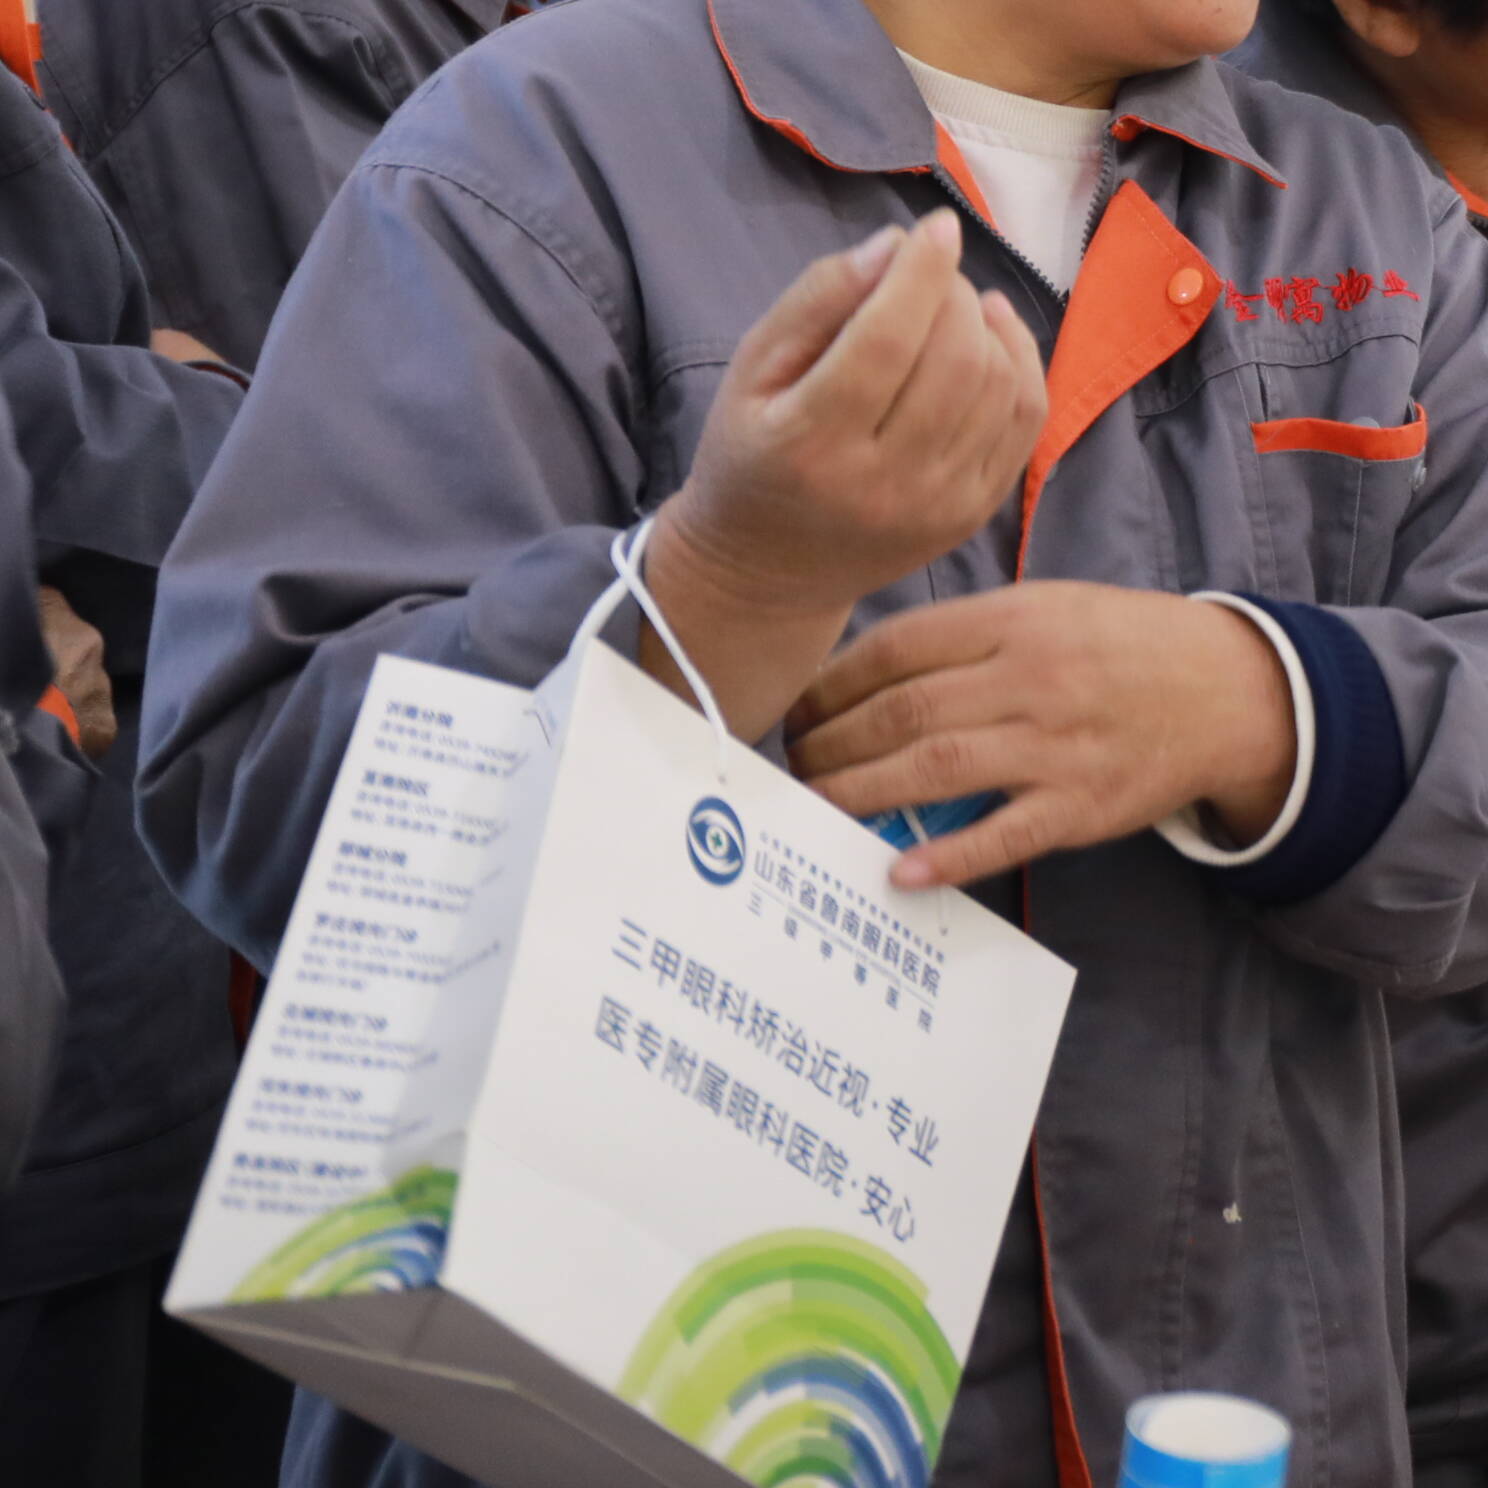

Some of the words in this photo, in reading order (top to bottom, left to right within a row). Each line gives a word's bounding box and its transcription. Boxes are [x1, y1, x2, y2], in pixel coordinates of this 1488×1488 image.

[753, 850, 942, 999] 山东省鲁南眼科医院
